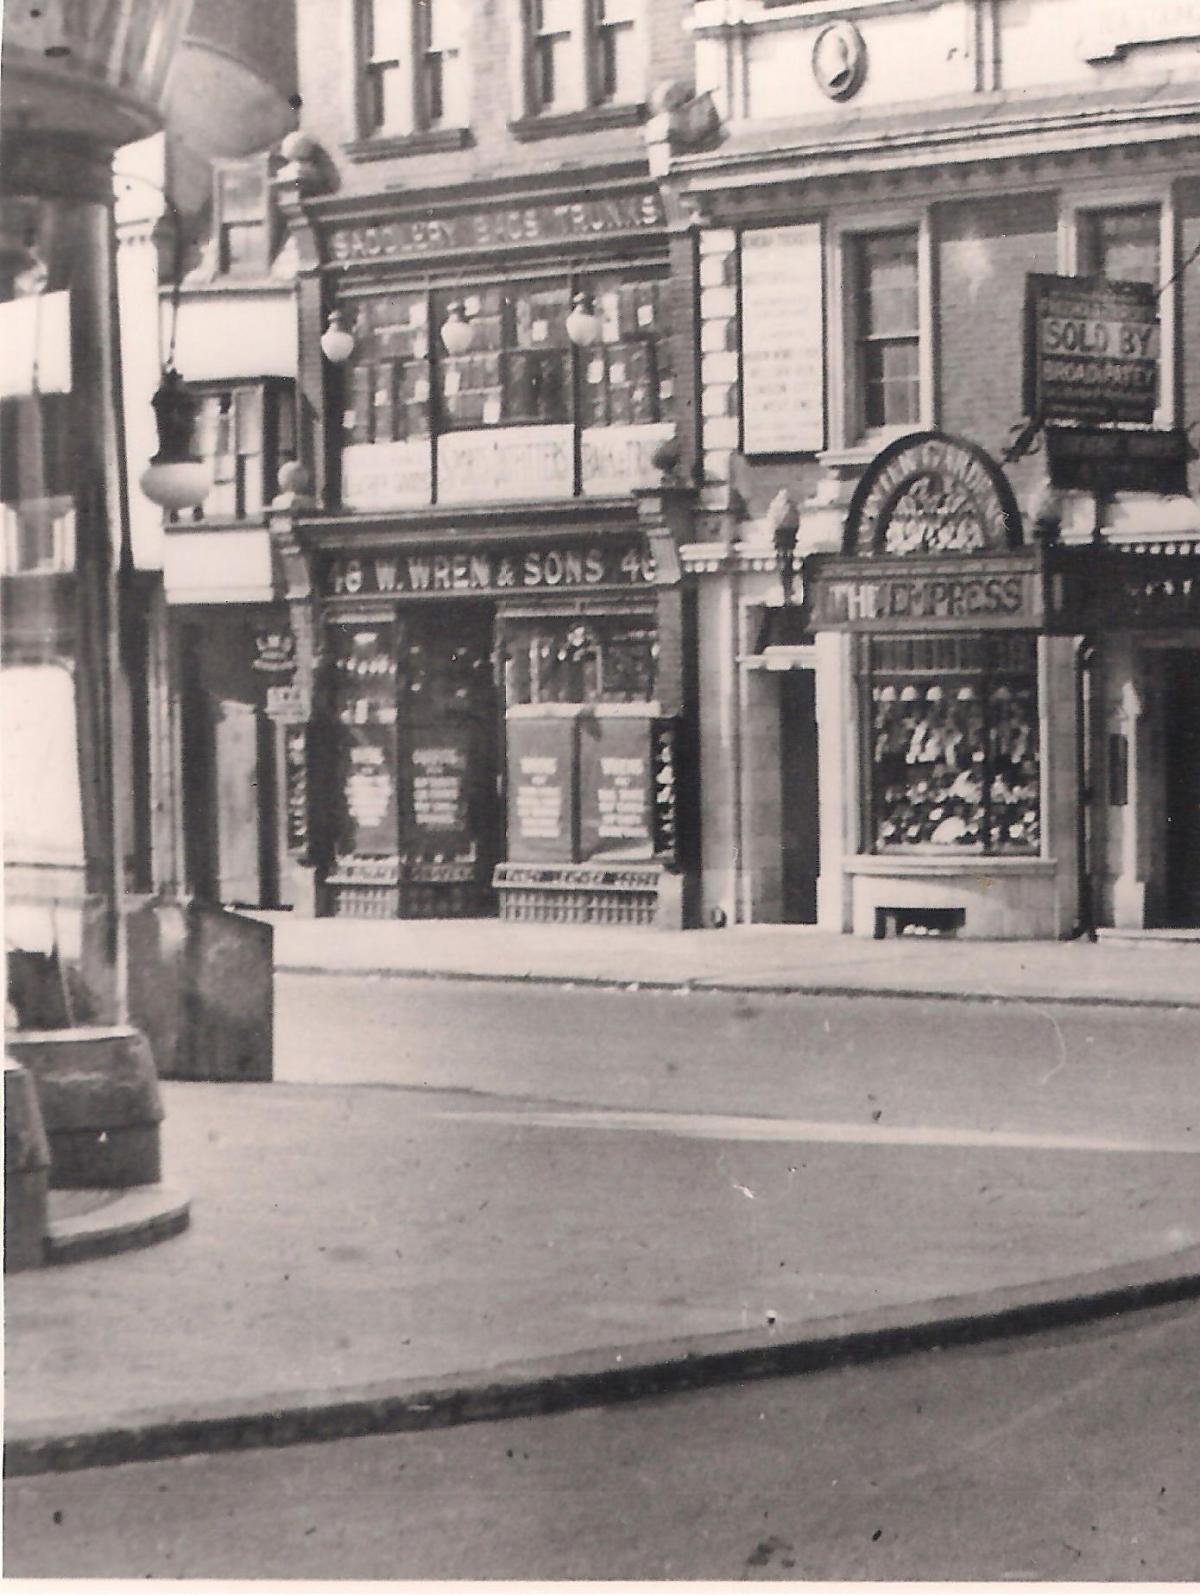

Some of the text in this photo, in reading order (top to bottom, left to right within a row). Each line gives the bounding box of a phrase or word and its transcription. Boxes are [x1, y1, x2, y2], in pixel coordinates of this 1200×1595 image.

[1043, 320, 1157, 356] SOLD BY
[408, 552, 491, 591] WREN
[497, 564, 515, 586] &
[523, 548, 606, 586] SONS
[888, 578, 1023, 618] EMPRESS
